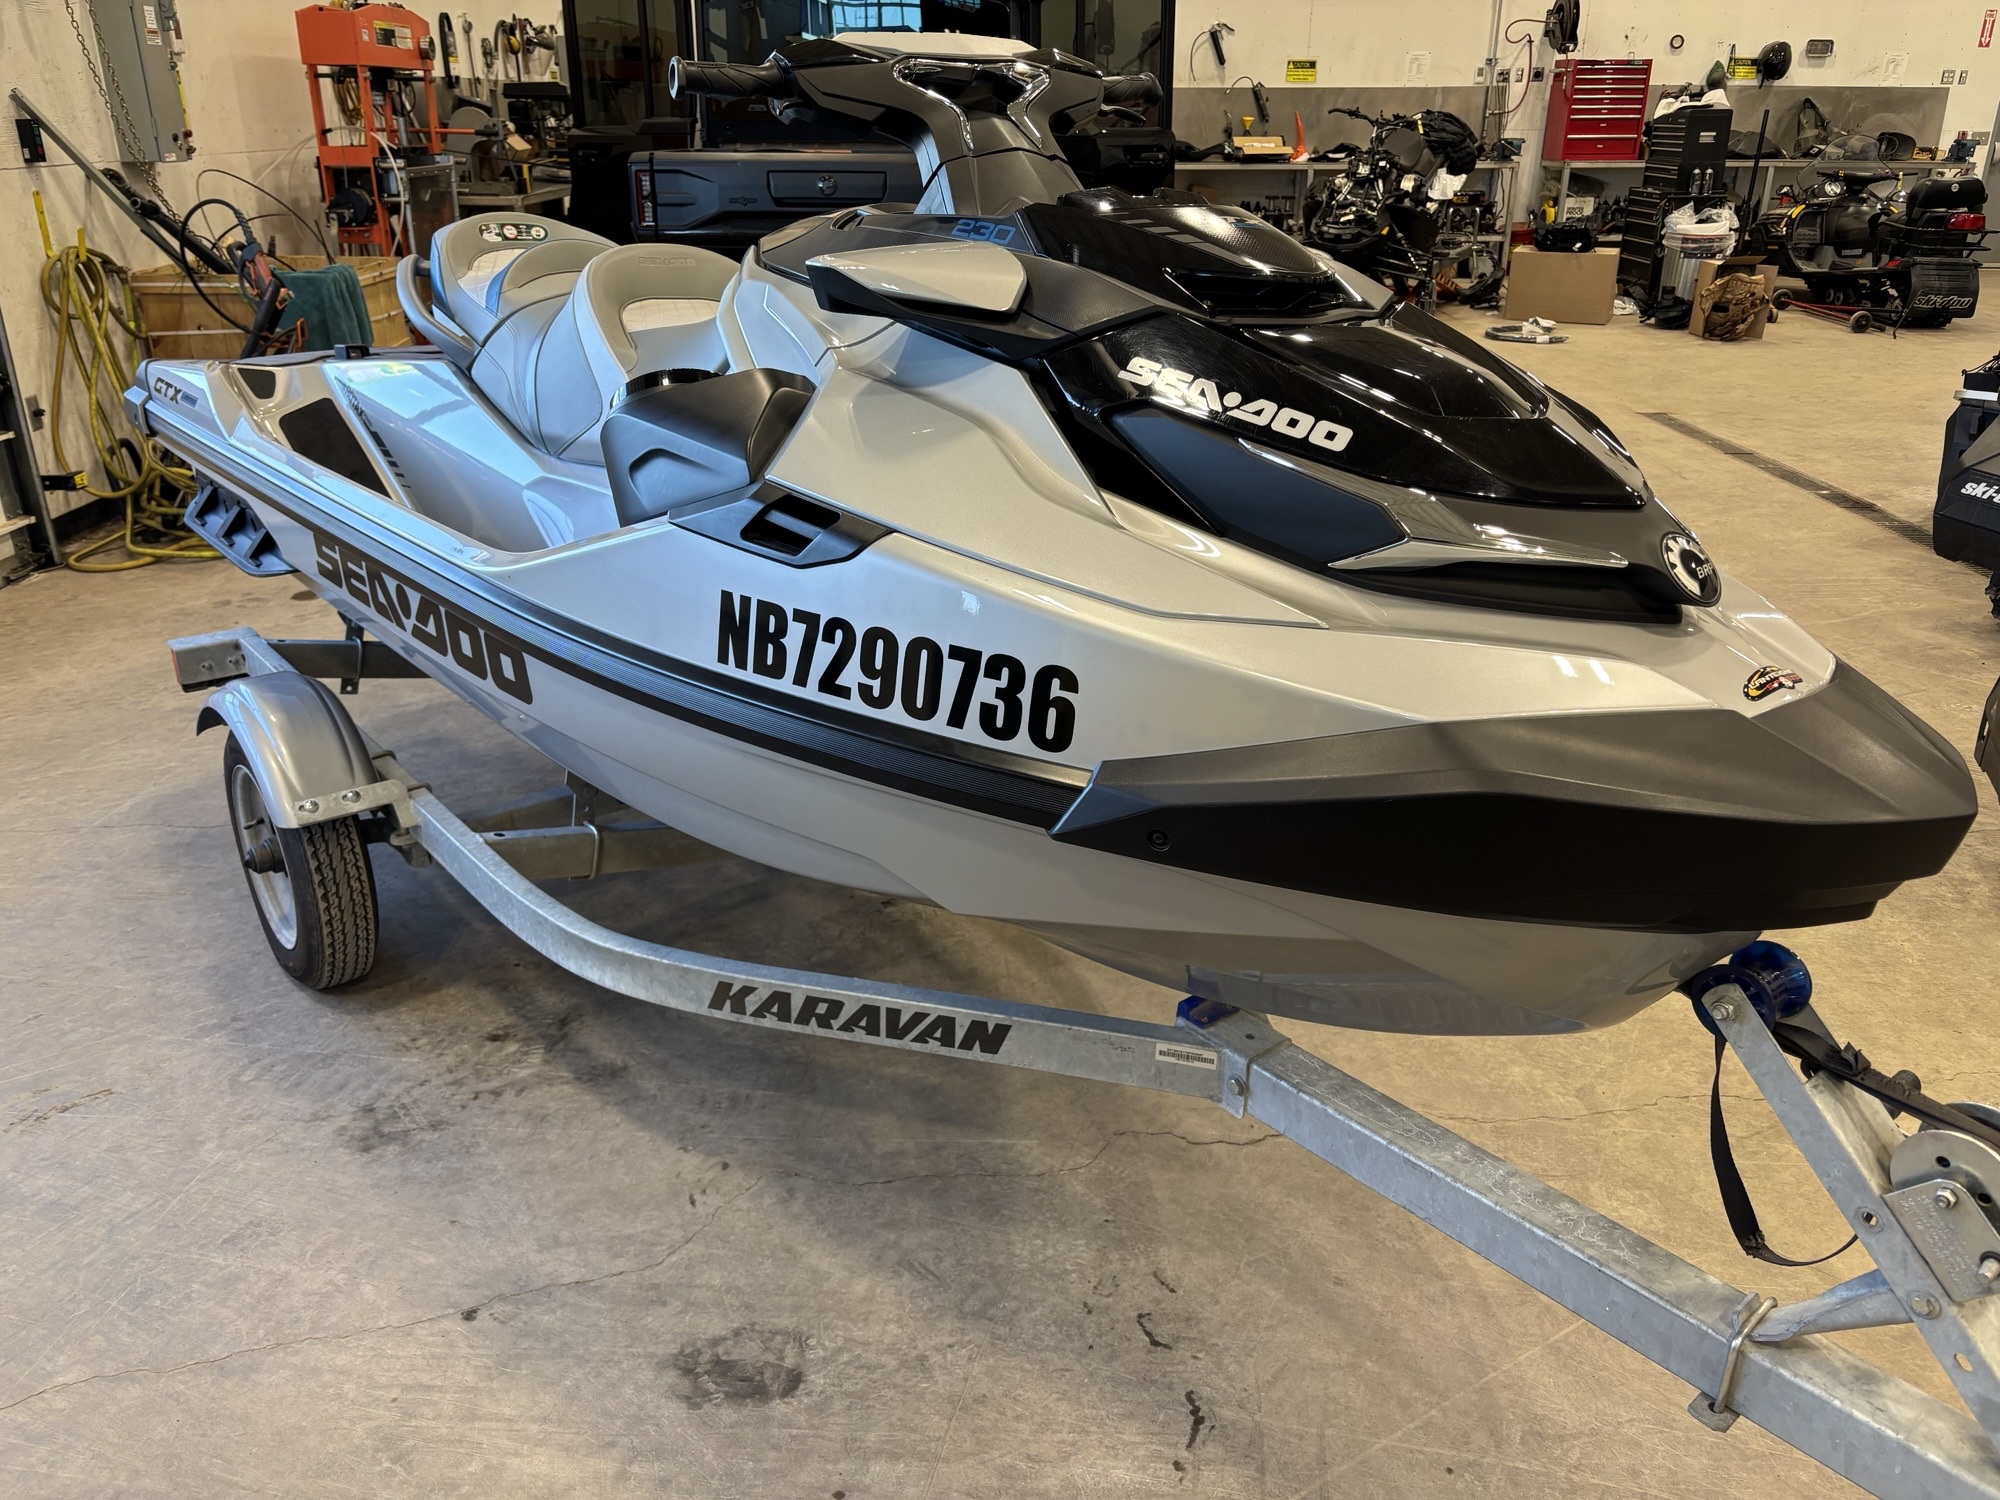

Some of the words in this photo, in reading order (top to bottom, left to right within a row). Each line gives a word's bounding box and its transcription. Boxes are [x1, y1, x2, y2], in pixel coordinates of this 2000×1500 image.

[951, 218, 1016, 246] 230
[153, 376, 184, 405] GTX
[1696, 562, 1714, 579] BRP
[716, 588, 1080, 754] NB7290736
[707, 980, 1013, 1056] KARAVAN
